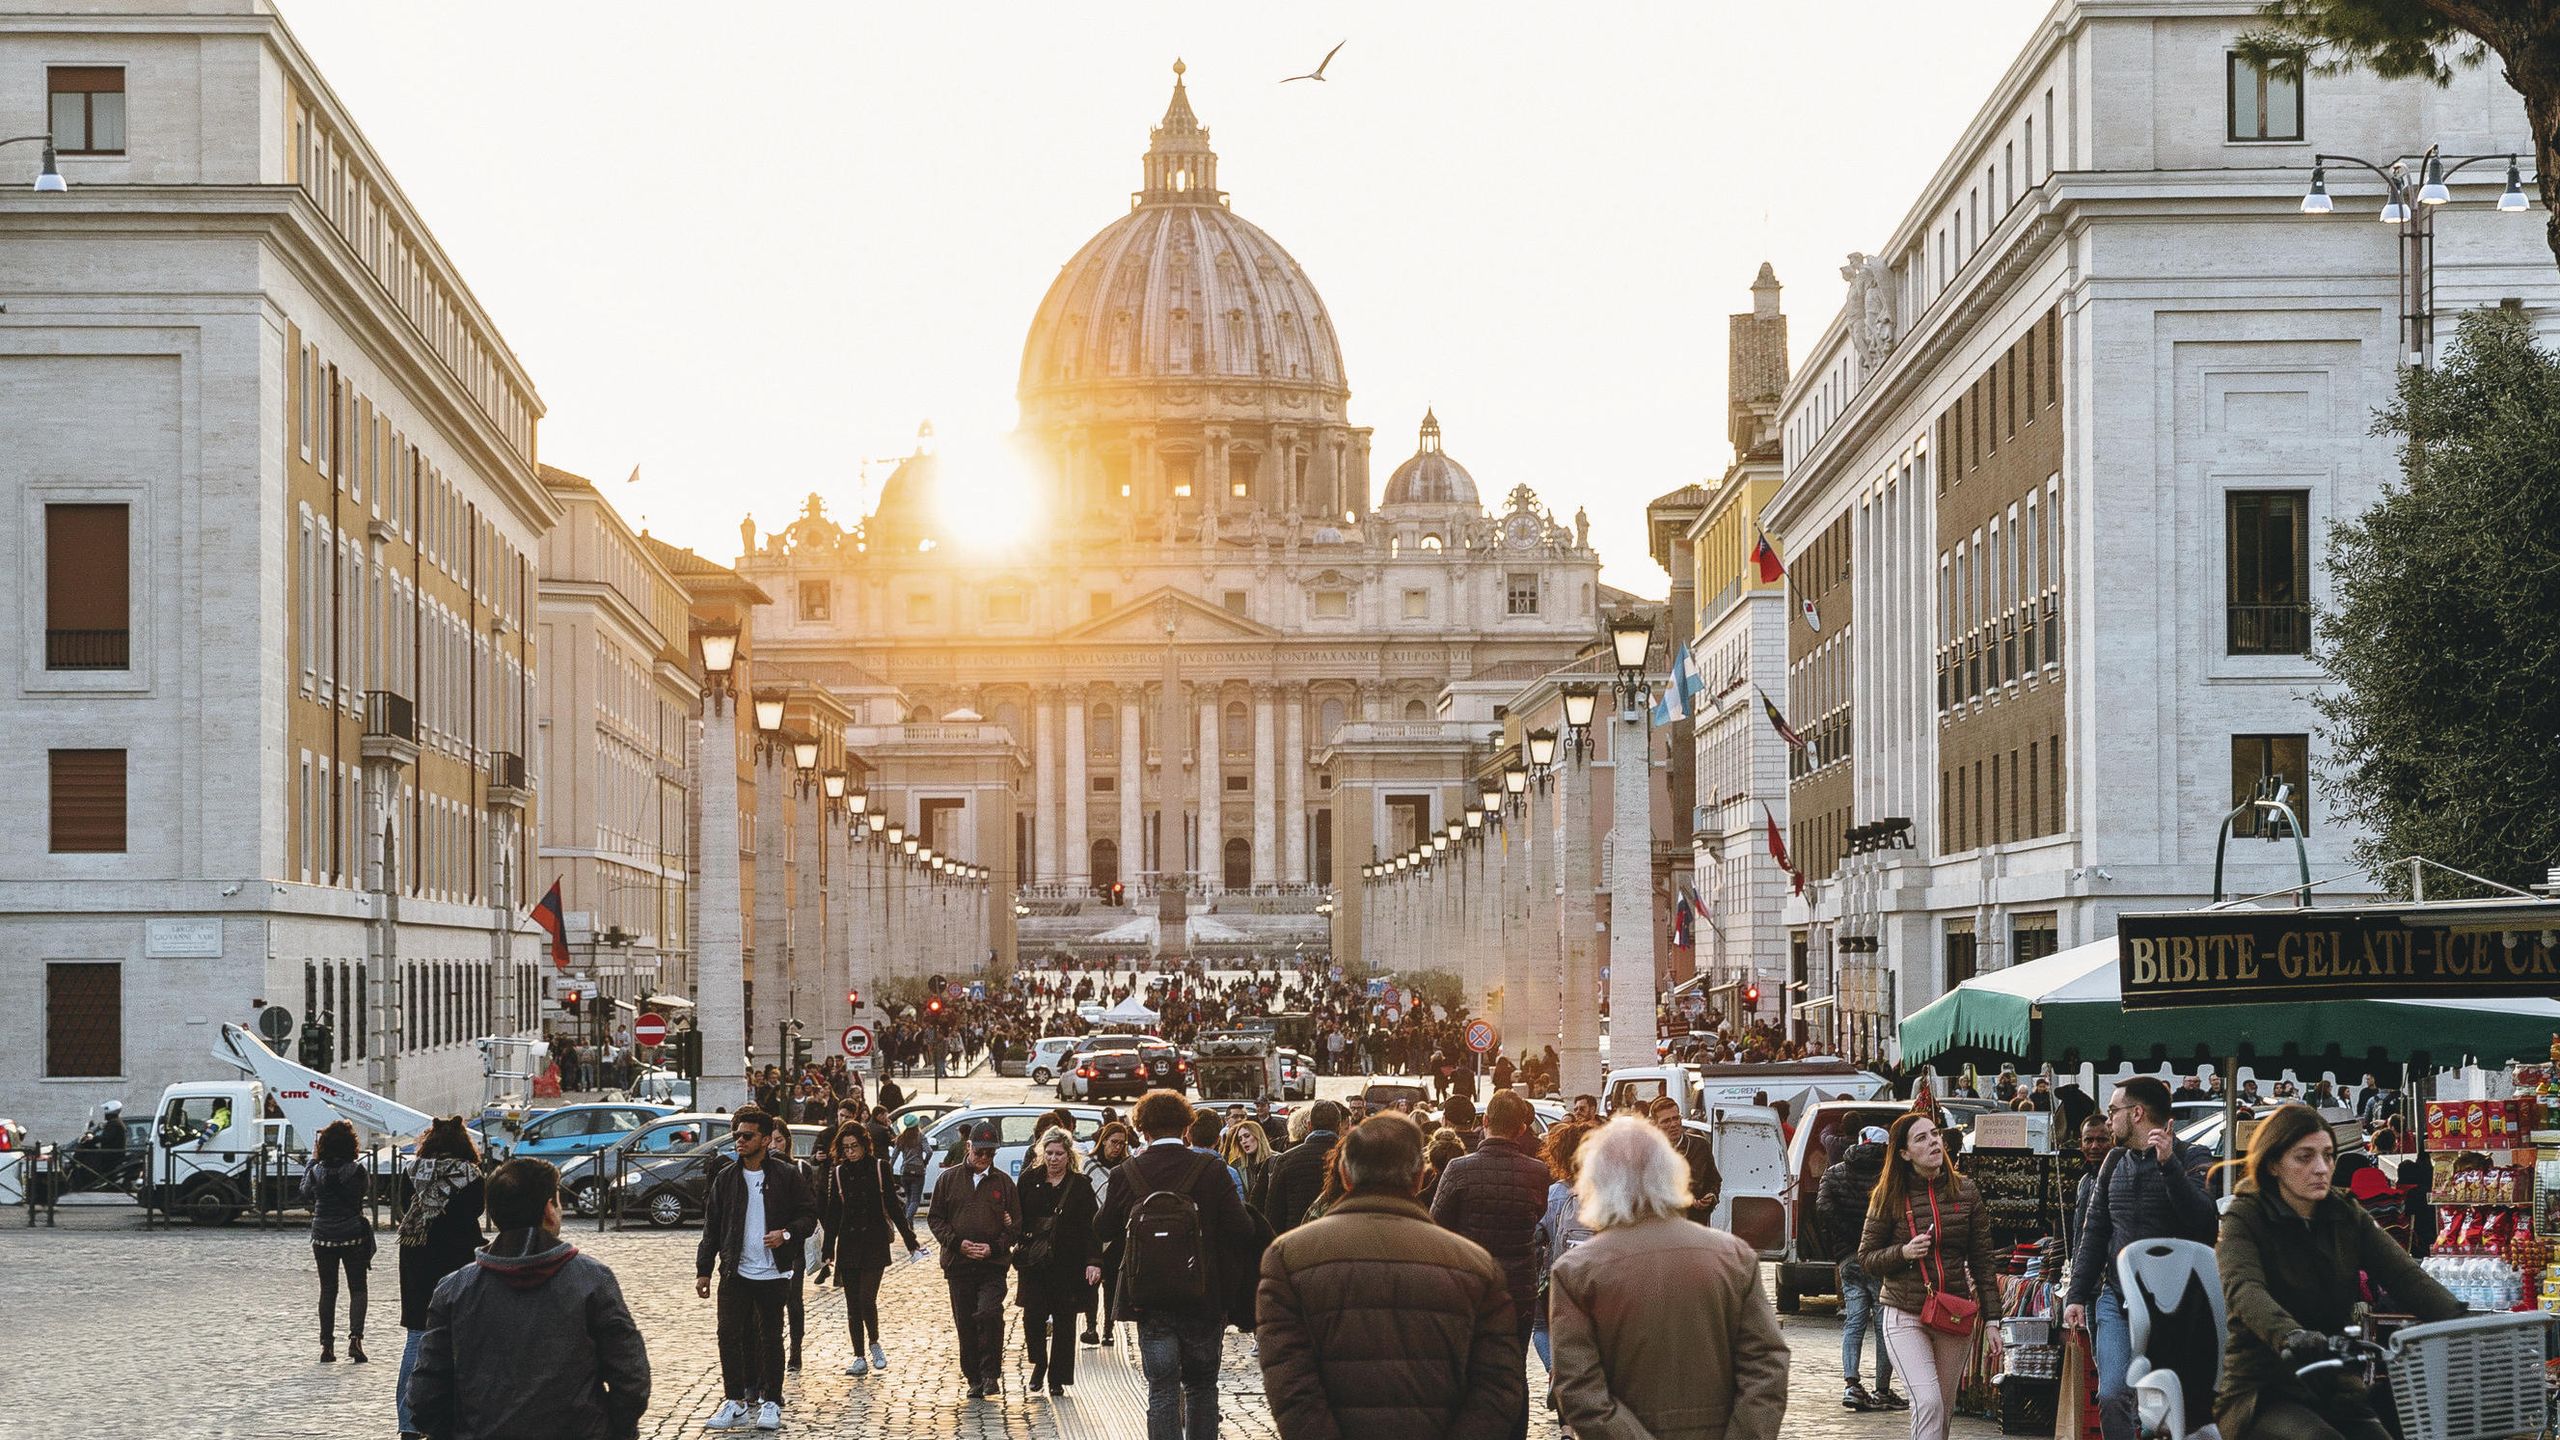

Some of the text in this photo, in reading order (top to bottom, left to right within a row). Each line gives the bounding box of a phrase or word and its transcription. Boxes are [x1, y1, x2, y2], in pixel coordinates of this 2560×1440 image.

[2503, 931, 2560, 974] CR
[280, 1090, 310, 1099] cmc
[308, 1080, 337, 1098] cmc
